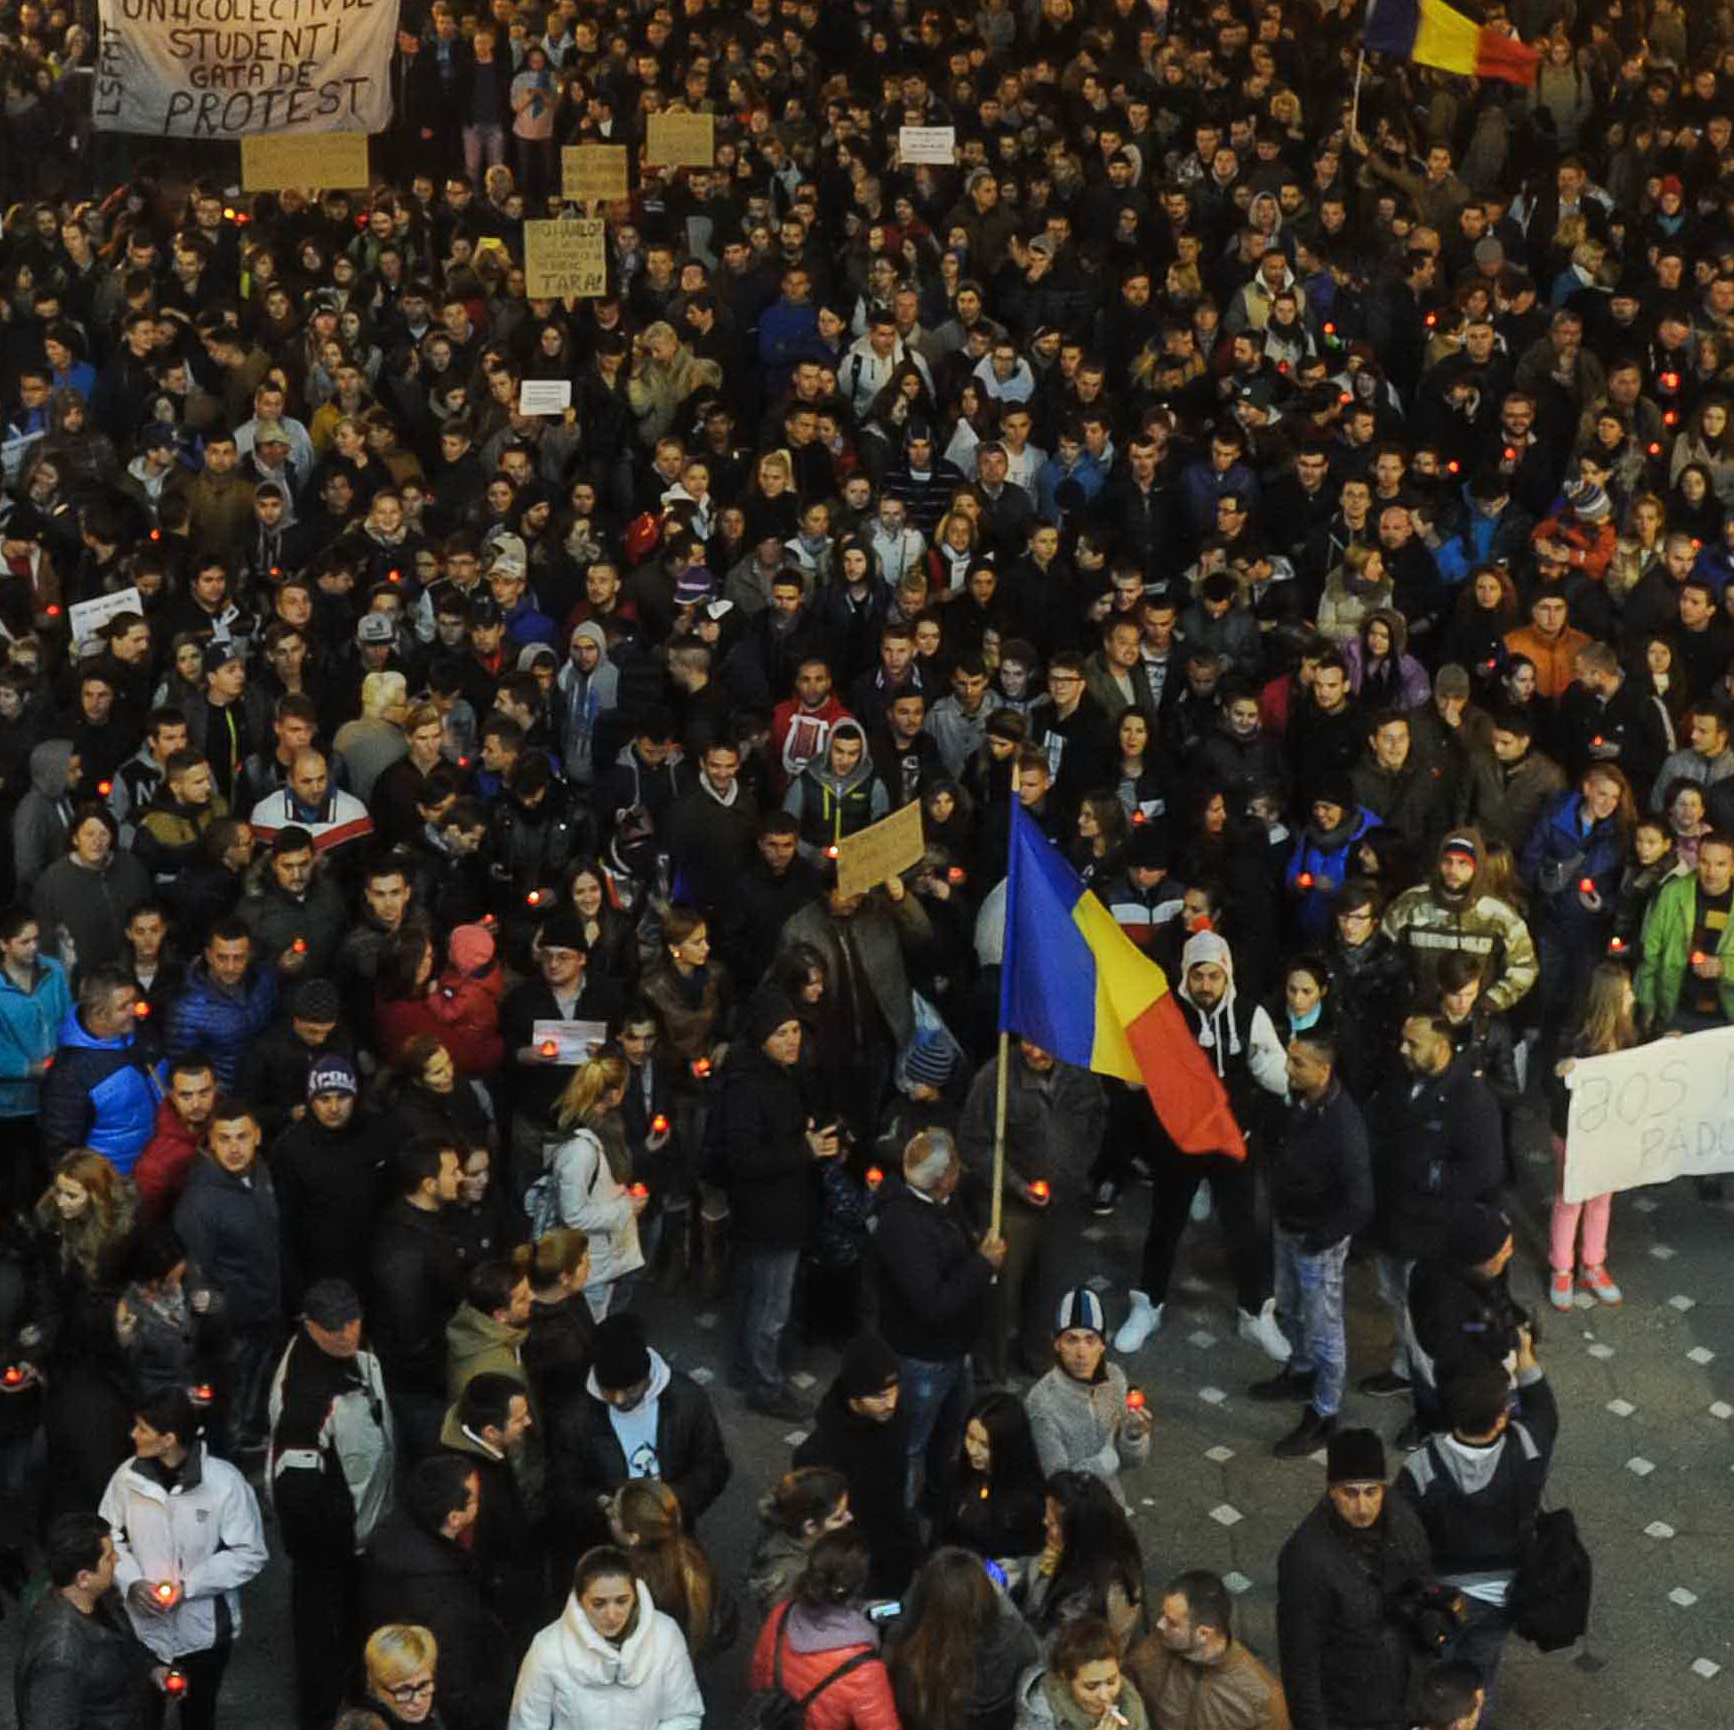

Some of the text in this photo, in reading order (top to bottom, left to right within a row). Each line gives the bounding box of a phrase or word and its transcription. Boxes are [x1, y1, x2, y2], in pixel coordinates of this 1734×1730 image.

[189, 60, 318, 90] GATA DE
[163, 76, 369, 137] PROTEST
